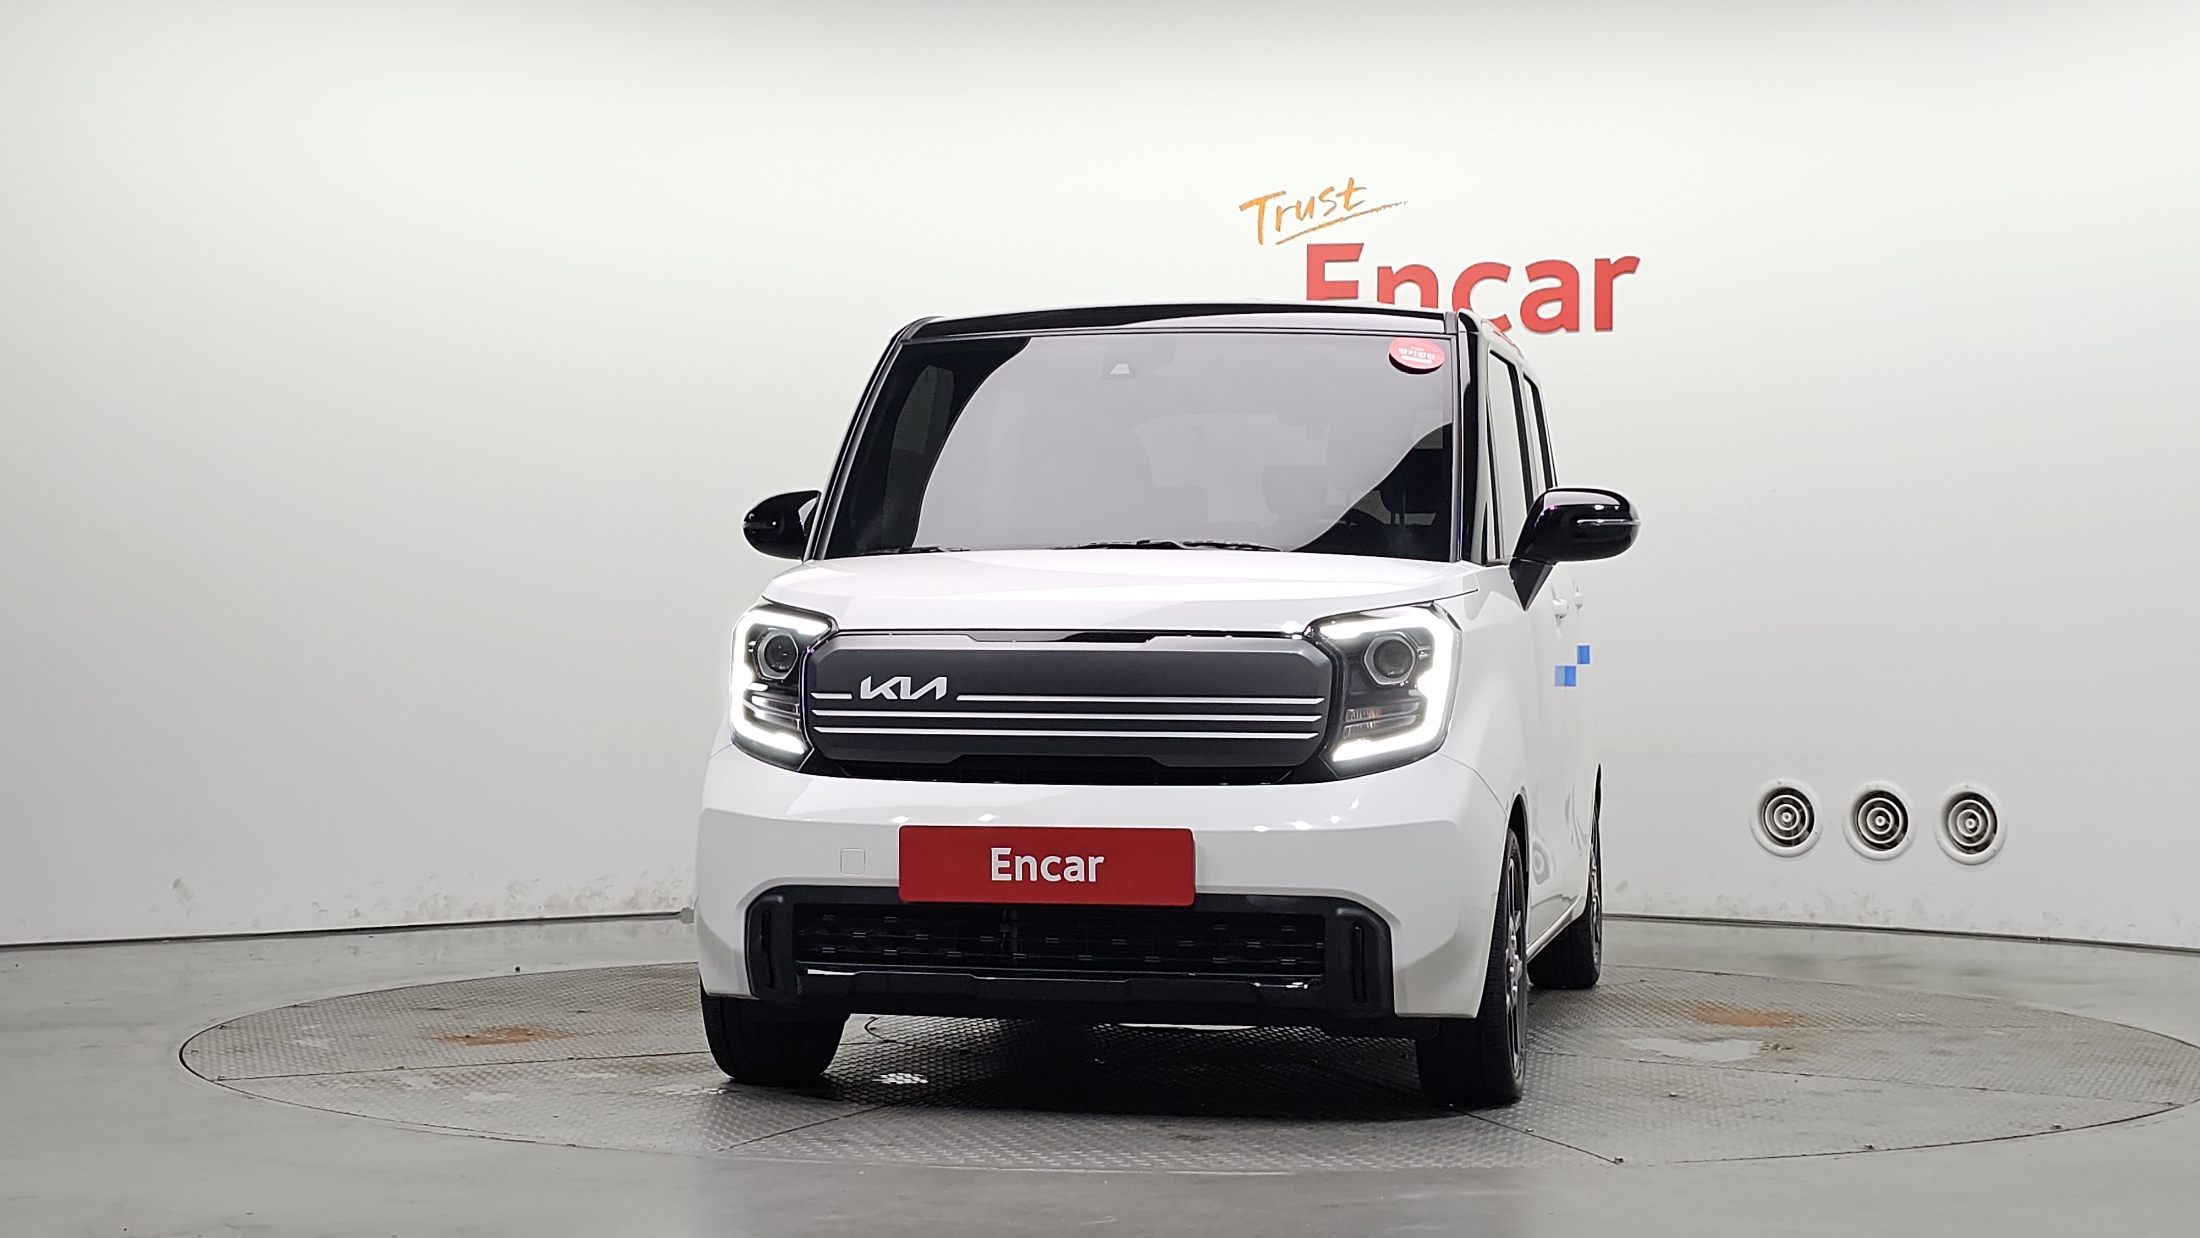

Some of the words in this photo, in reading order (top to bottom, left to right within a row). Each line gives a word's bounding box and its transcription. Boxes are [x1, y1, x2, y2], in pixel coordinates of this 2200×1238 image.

[1239, 177, 1367, 245] Trust
[1307, 243, 1640, 332] Encar
[990, 847, 1105, 883] Encar
